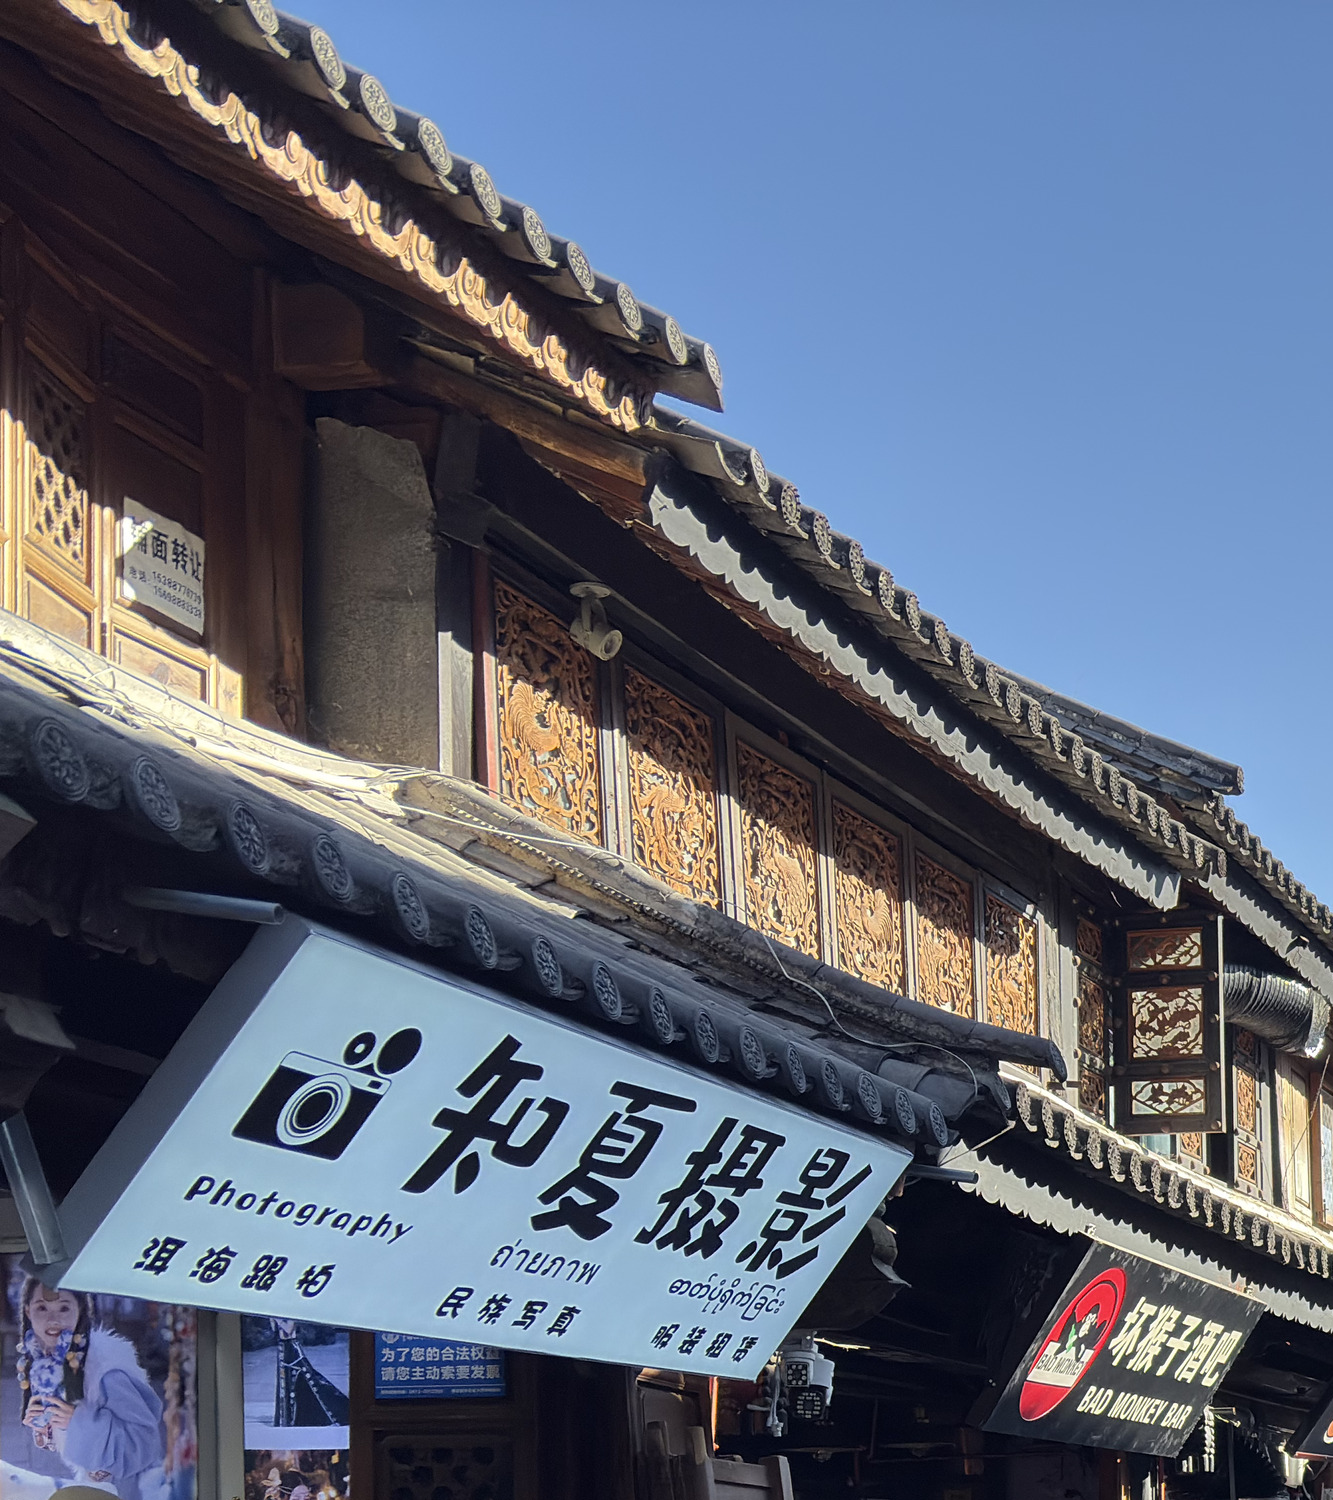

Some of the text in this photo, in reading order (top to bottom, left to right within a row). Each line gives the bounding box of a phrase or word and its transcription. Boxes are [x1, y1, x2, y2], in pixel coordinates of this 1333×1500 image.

[402, 1034, 873, 1282] 知夏摄影
[183, 1174, 414, 1245] Photography
[133, 1235, 336, 1300] 洱海跟拍
[489, 1236, 603, 1287] ถ่ายภาพ
[435, 1285, 585, 1337] 民族写真
[381, 1345, 501, 1362] 为了您的合法权益
[650, 1323, 760, 1364] 服装租赁
[1107, 1296, 1243, 1388] 坏猴子酒吧
[381, 1364, 501, 1381] 请您主动索要发票
[1076, 1385, 1193, 1431] BAD MONKEY BAR
